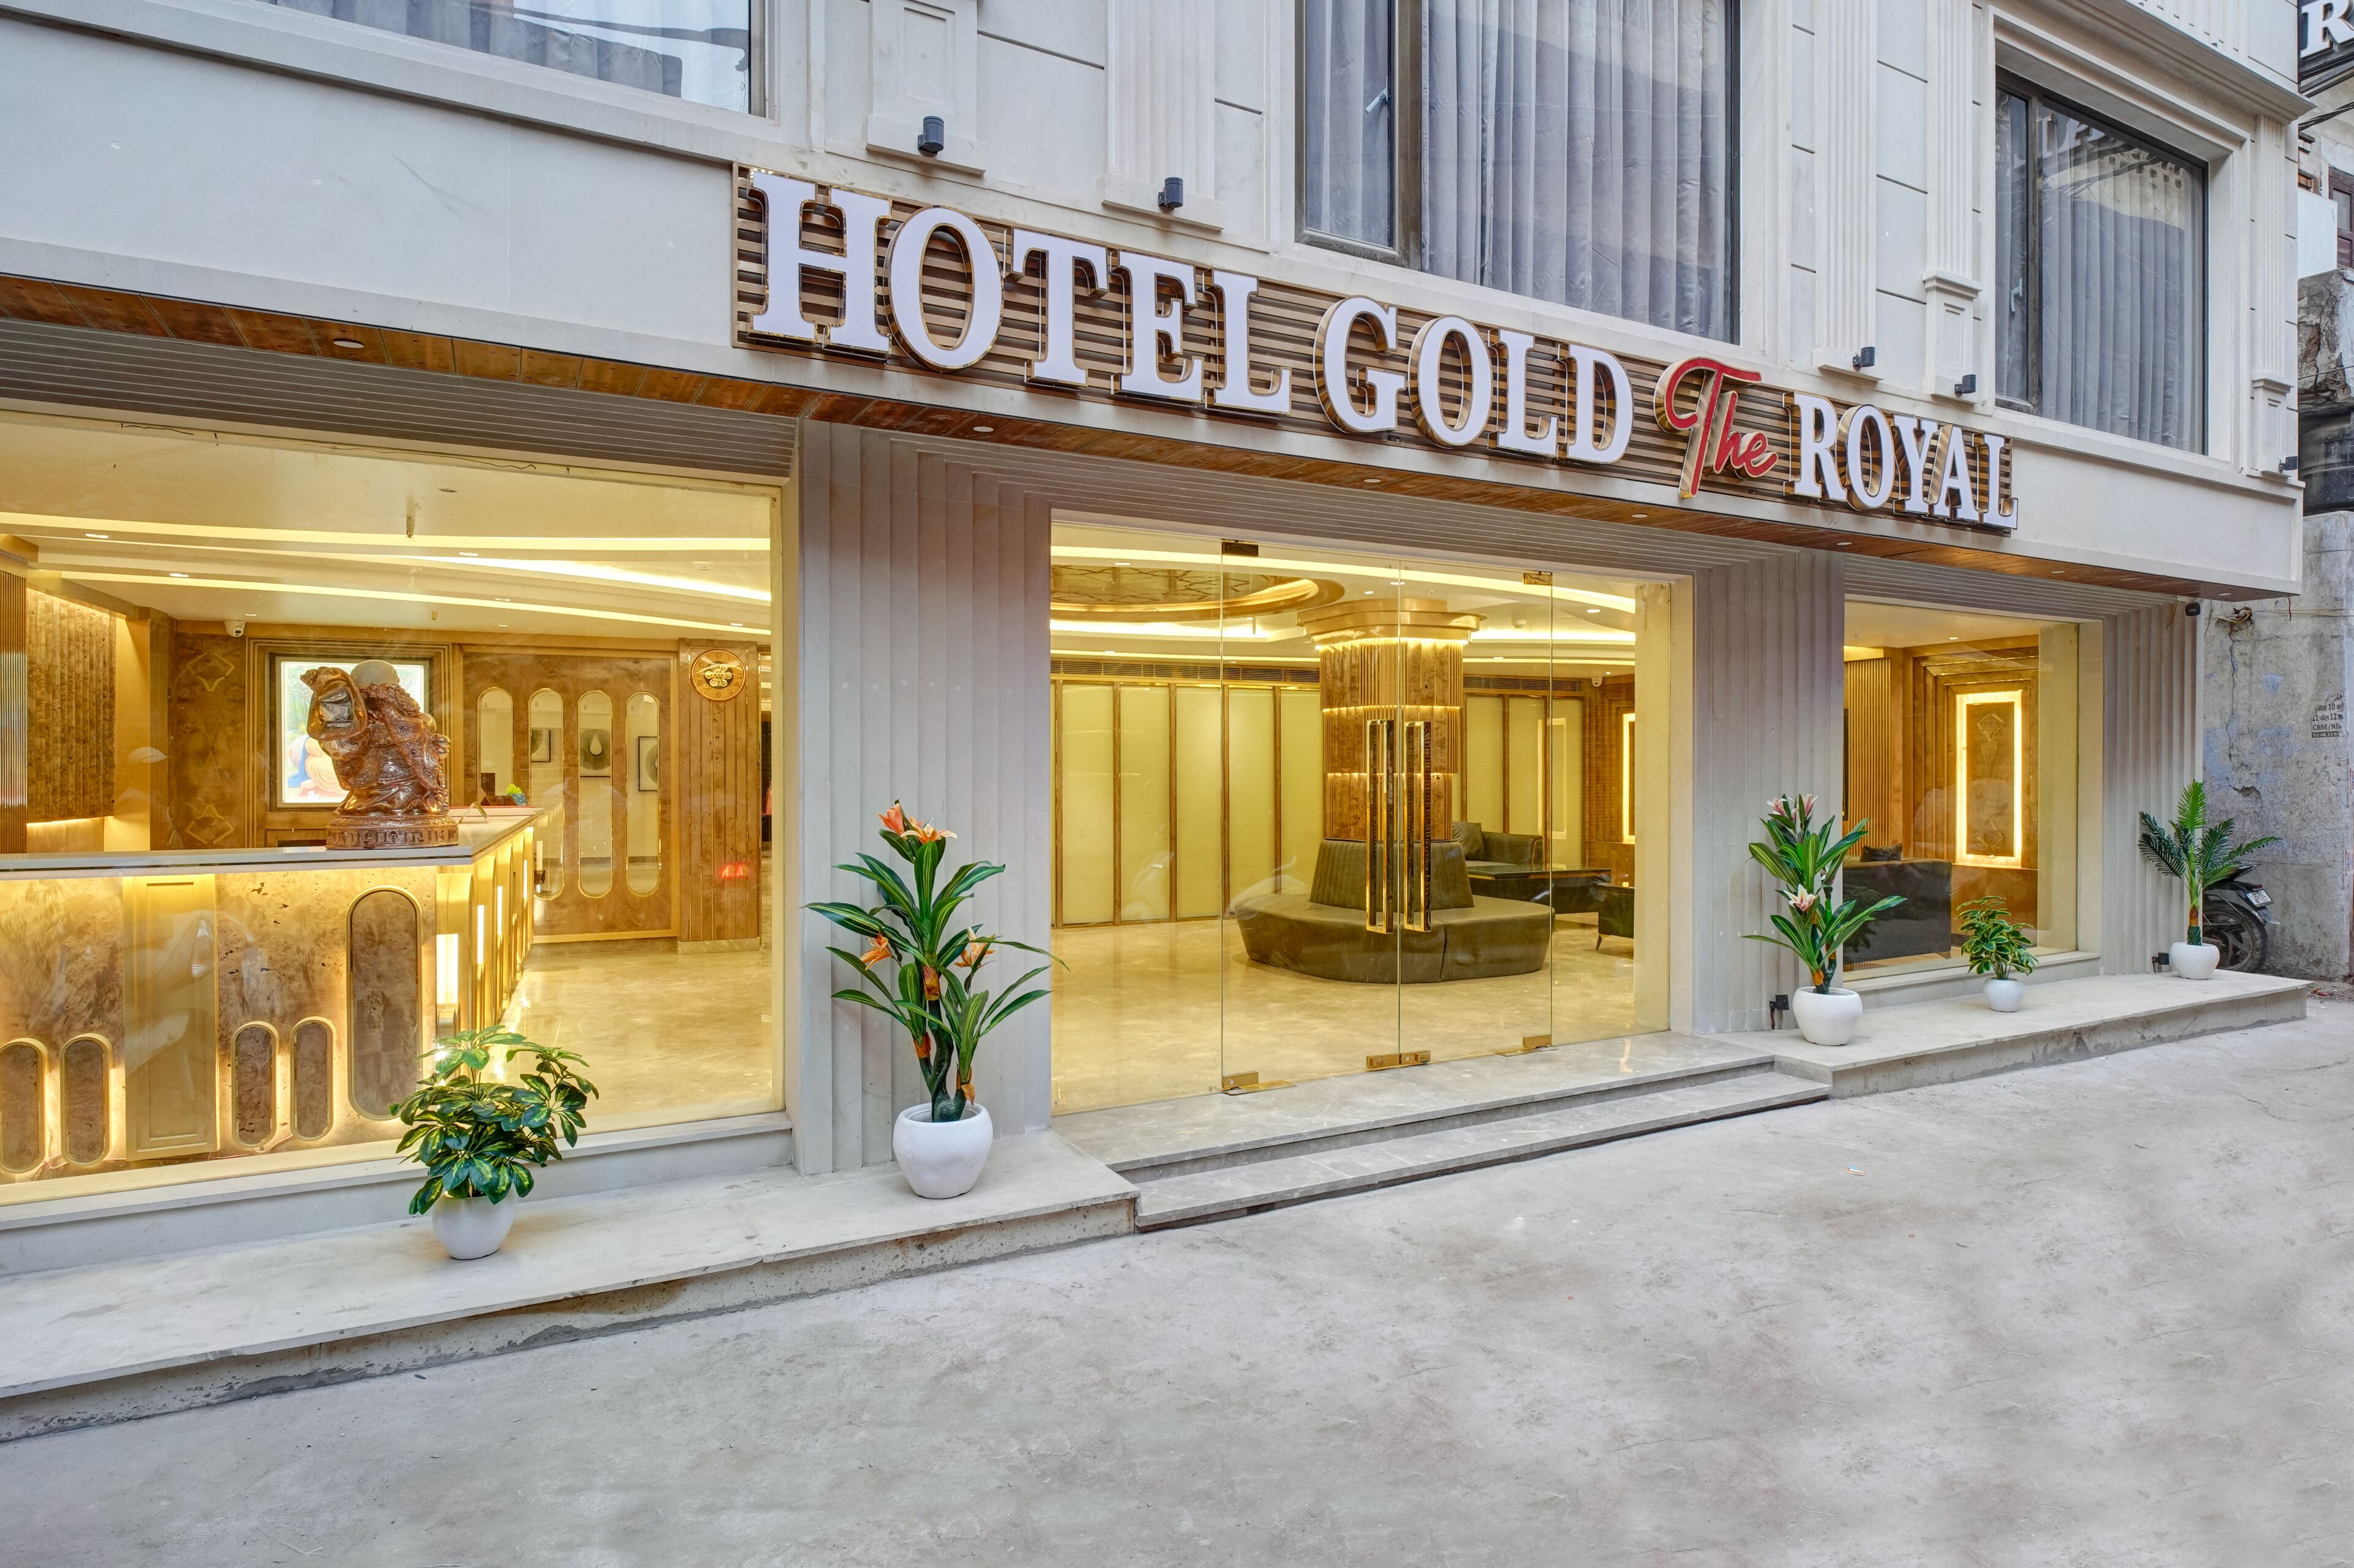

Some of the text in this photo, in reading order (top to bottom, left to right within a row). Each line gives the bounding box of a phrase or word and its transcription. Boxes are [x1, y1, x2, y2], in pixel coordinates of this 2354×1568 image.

[748, 169, 2018, 530] HOTEL GOLD The ROYAL
